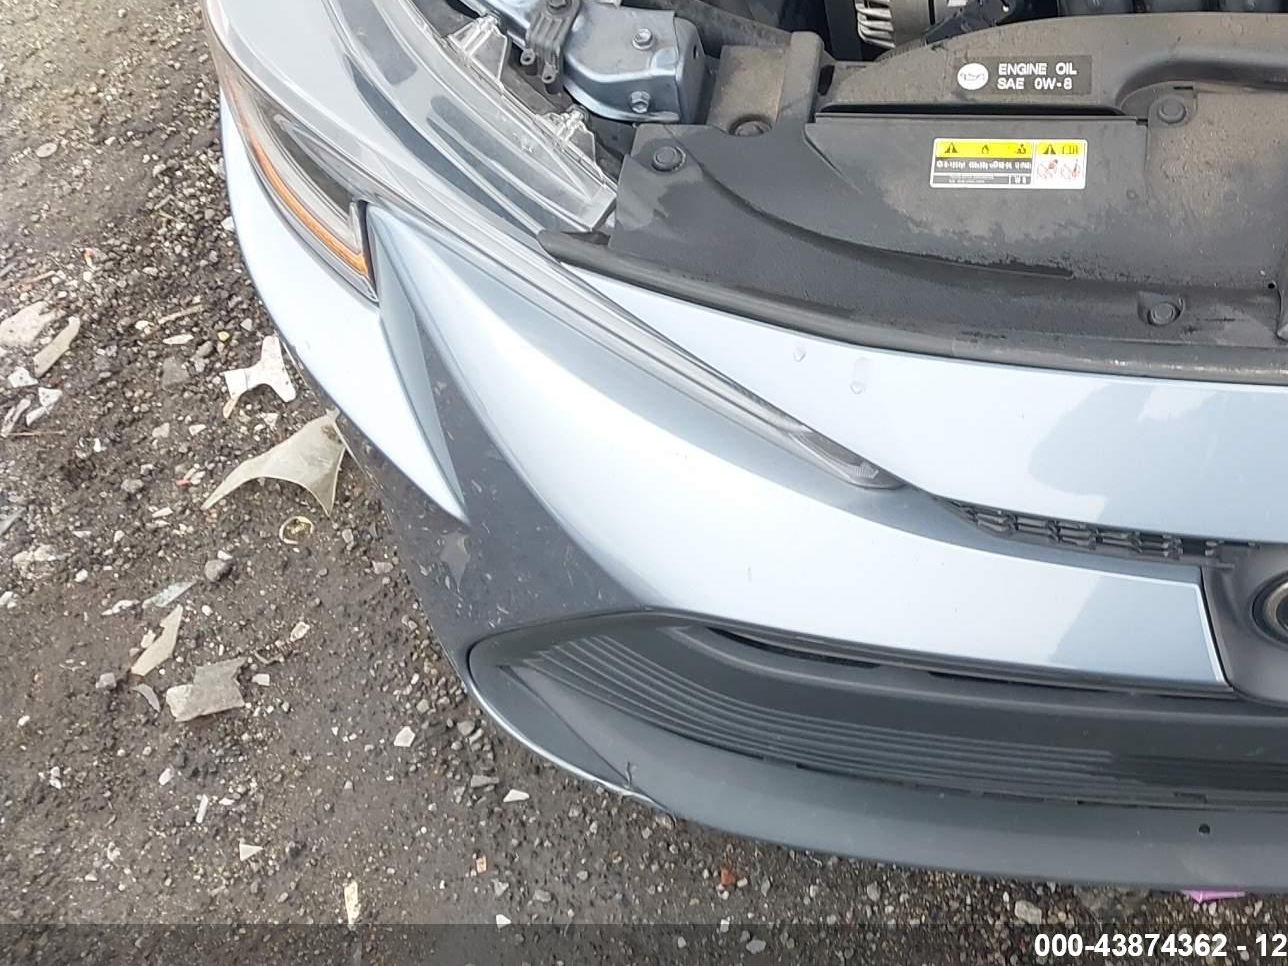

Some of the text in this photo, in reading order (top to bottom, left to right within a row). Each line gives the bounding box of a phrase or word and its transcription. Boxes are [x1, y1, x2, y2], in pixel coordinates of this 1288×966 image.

[998, 62, 1077, 76] ENGINE OIL
[997, 77, 1073, 90] SAE 0W-8
